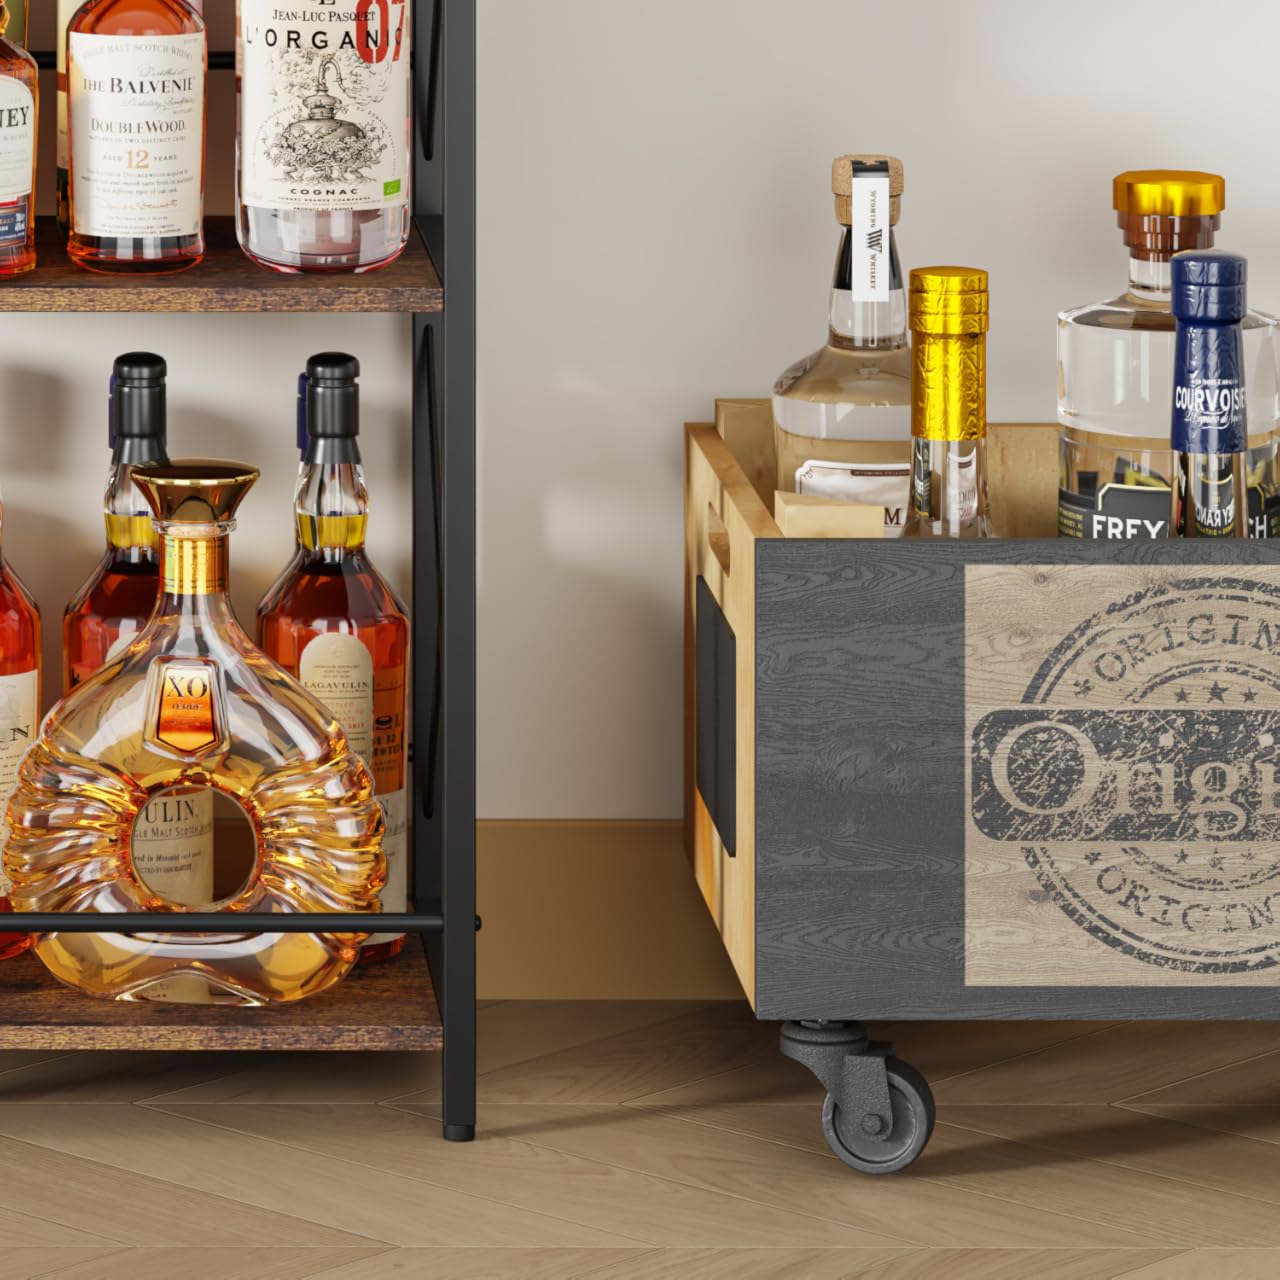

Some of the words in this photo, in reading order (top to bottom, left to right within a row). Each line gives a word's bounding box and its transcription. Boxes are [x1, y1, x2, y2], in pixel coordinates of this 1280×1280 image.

[272, 9, 326, 22] JEAN-LUC
[329, 11, 376, 22] PASQUET
[83, 78, 105, 92] THE
[110, 76, 193, 94] BALVENIE
[126, 149, 150, 169] 12
[290, 187, 359, 196] COGNAC
[1092, 514, 1166, 540] FREY
[167, 675, 208, 698] XO
[303, 680, 369, 690] LAGAVULIN
[152, 826, 173, 838] MALT
